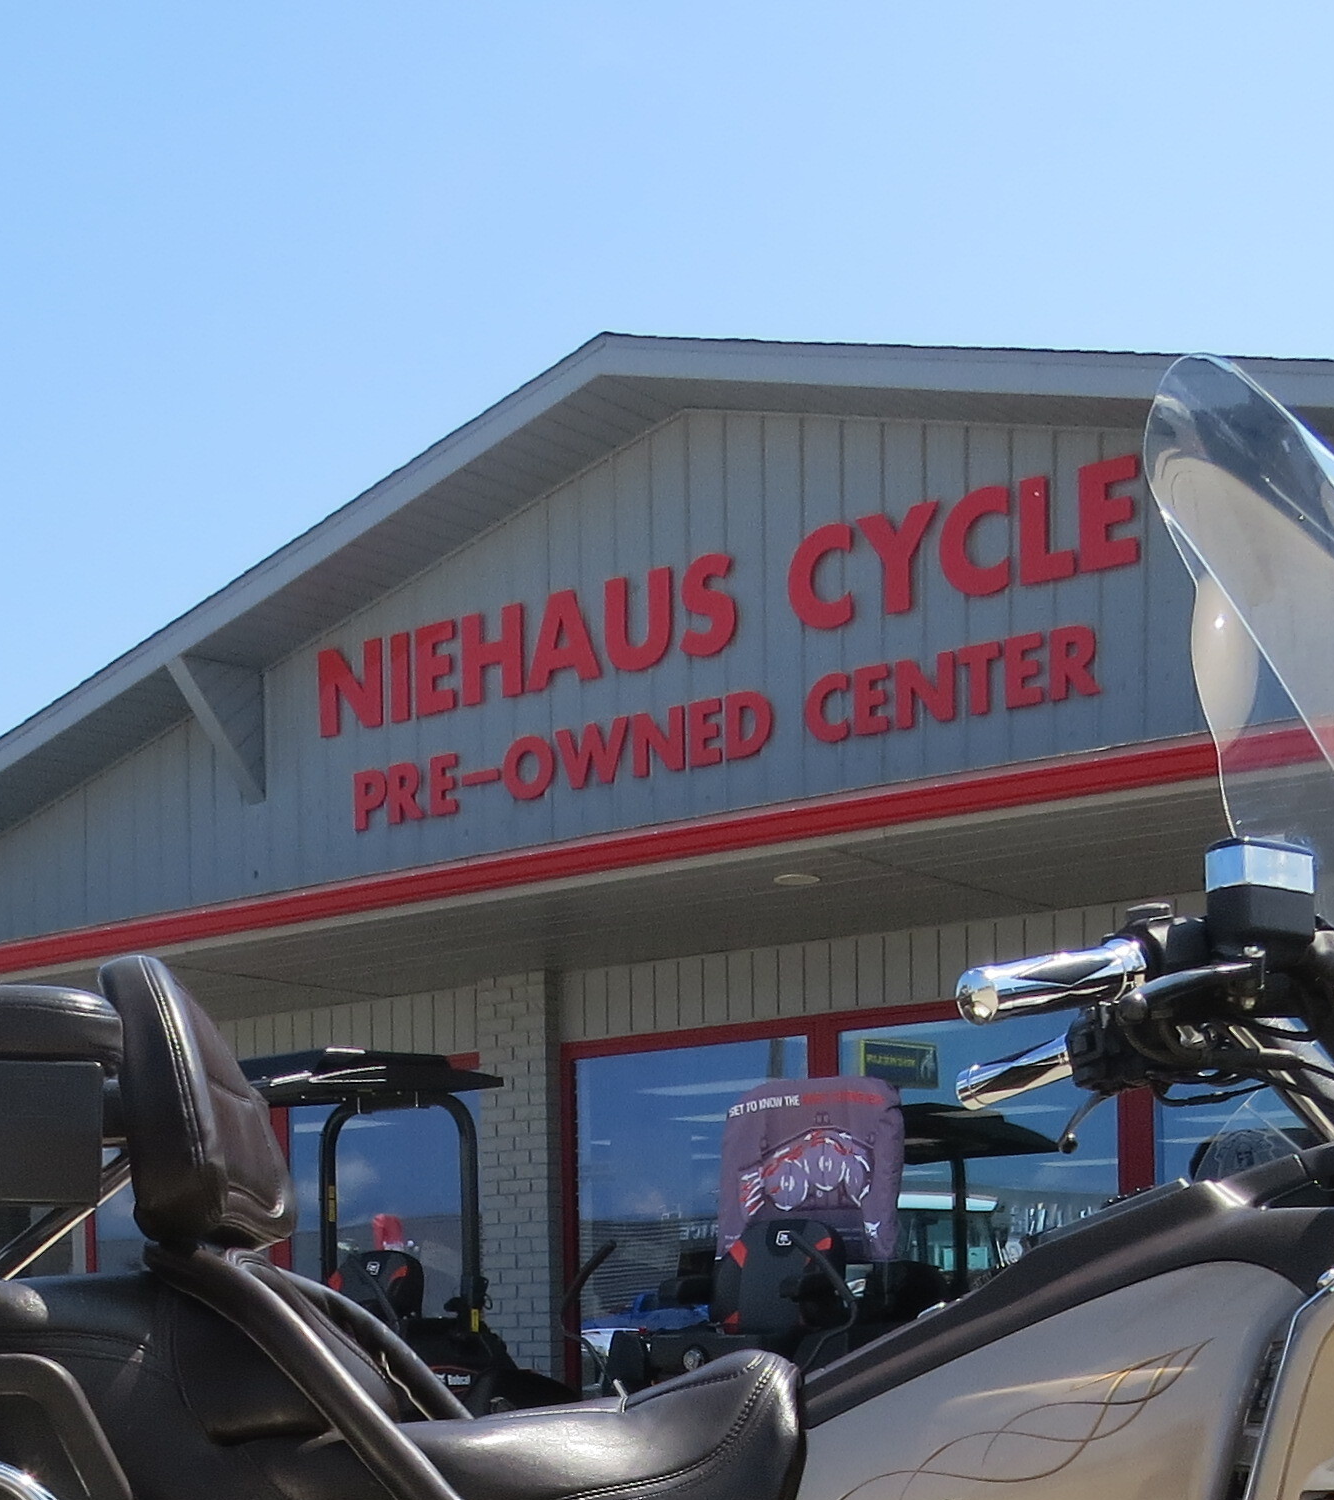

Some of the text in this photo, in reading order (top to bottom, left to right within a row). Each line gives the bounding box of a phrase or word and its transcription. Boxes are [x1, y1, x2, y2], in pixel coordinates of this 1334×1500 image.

[317, 454, 1140, 738] NIEHAUS CYCLE
[354, 625, 1101, 830] PRE-OWNED CENTER
[746, 1100, 758, 1113] TO
[759, 1096, 783, 1110] KNOW
[784, 1094, 801, 1106] THE
